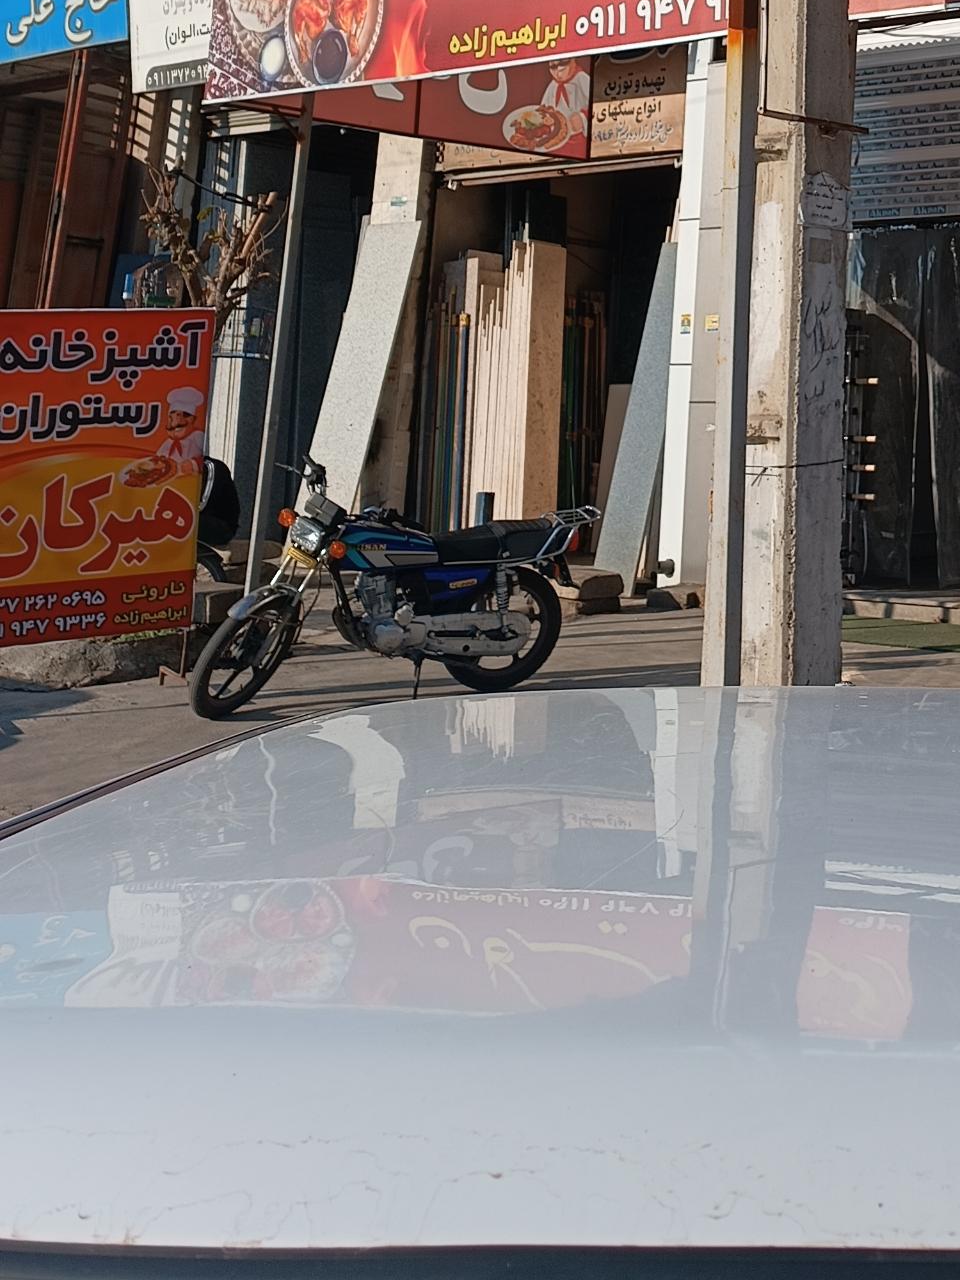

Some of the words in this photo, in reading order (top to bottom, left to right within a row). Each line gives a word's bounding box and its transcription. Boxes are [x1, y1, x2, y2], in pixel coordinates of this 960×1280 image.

[575, 3, 626, 37] ۰۹۱۱
[0, 319, 208, 389] آشپزخانه
[0, 393, 162, 442] رستوران
[25, 593, 58, 612] ۲۶۲
[62, 590, 106, 607] ۰۶۹۵
[11, 619, 50, 637] ۹۴۷
[54, 612, 107, 632] ۹۳۳۶
